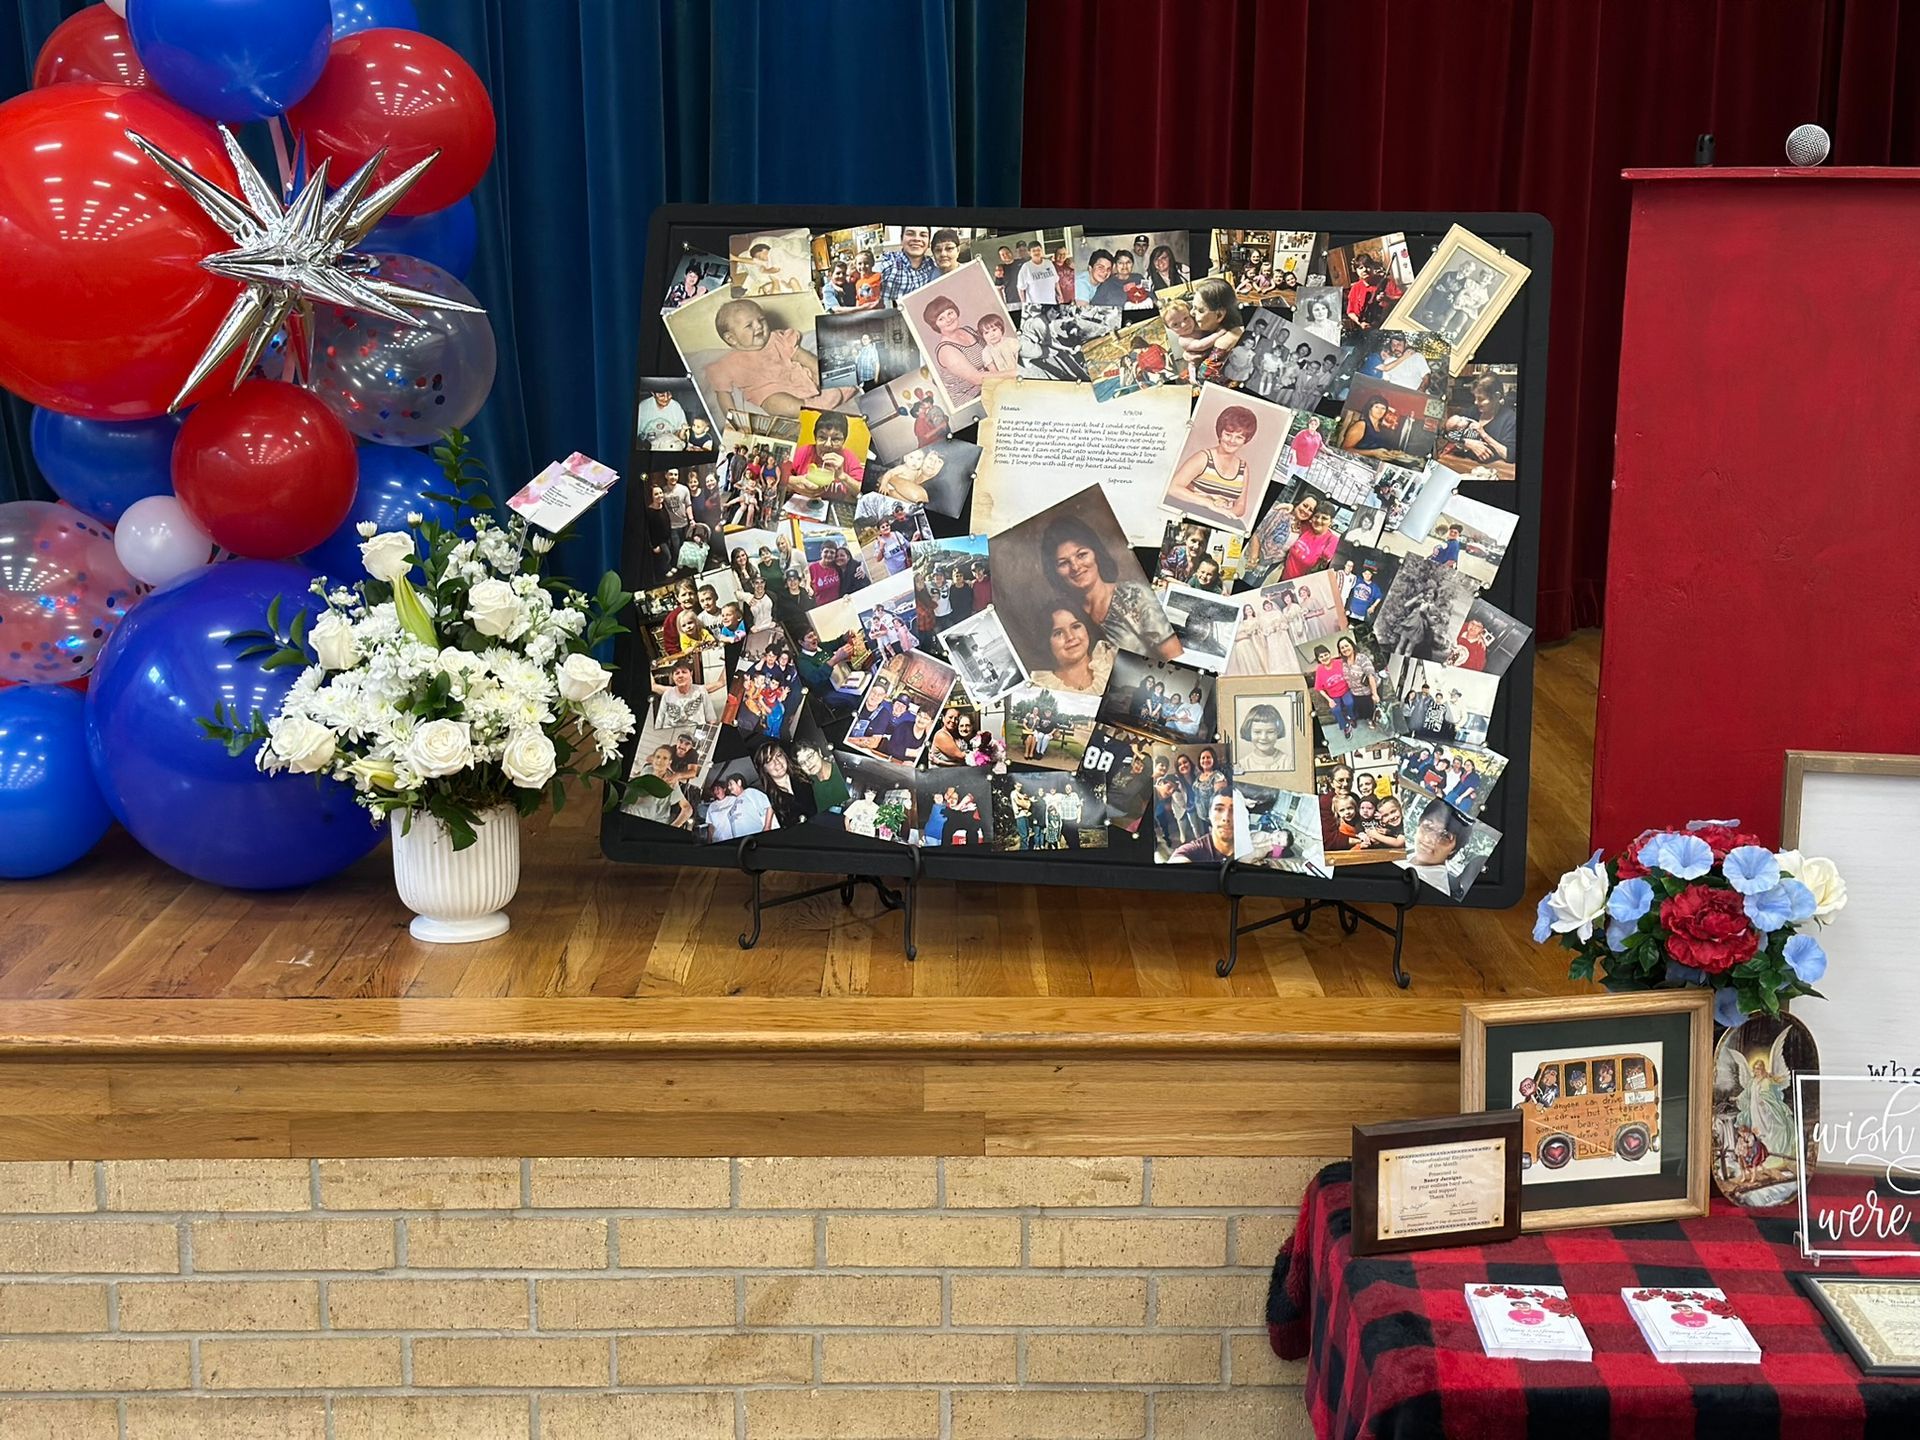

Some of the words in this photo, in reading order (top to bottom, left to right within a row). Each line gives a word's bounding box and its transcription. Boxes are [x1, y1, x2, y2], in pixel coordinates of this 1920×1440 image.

[1083, 745, 1115, 773] 88
[1587, 1108, 1600, 1117] but
[1619, 1105, 1644, 1113] takes
[1605, 1113, 1635, 1127] special
[1812, 1083, 1920, 1154] wish
[1577, 1130, 1598, 1138] drive
[1818, 1190, 1911, 1241] were
